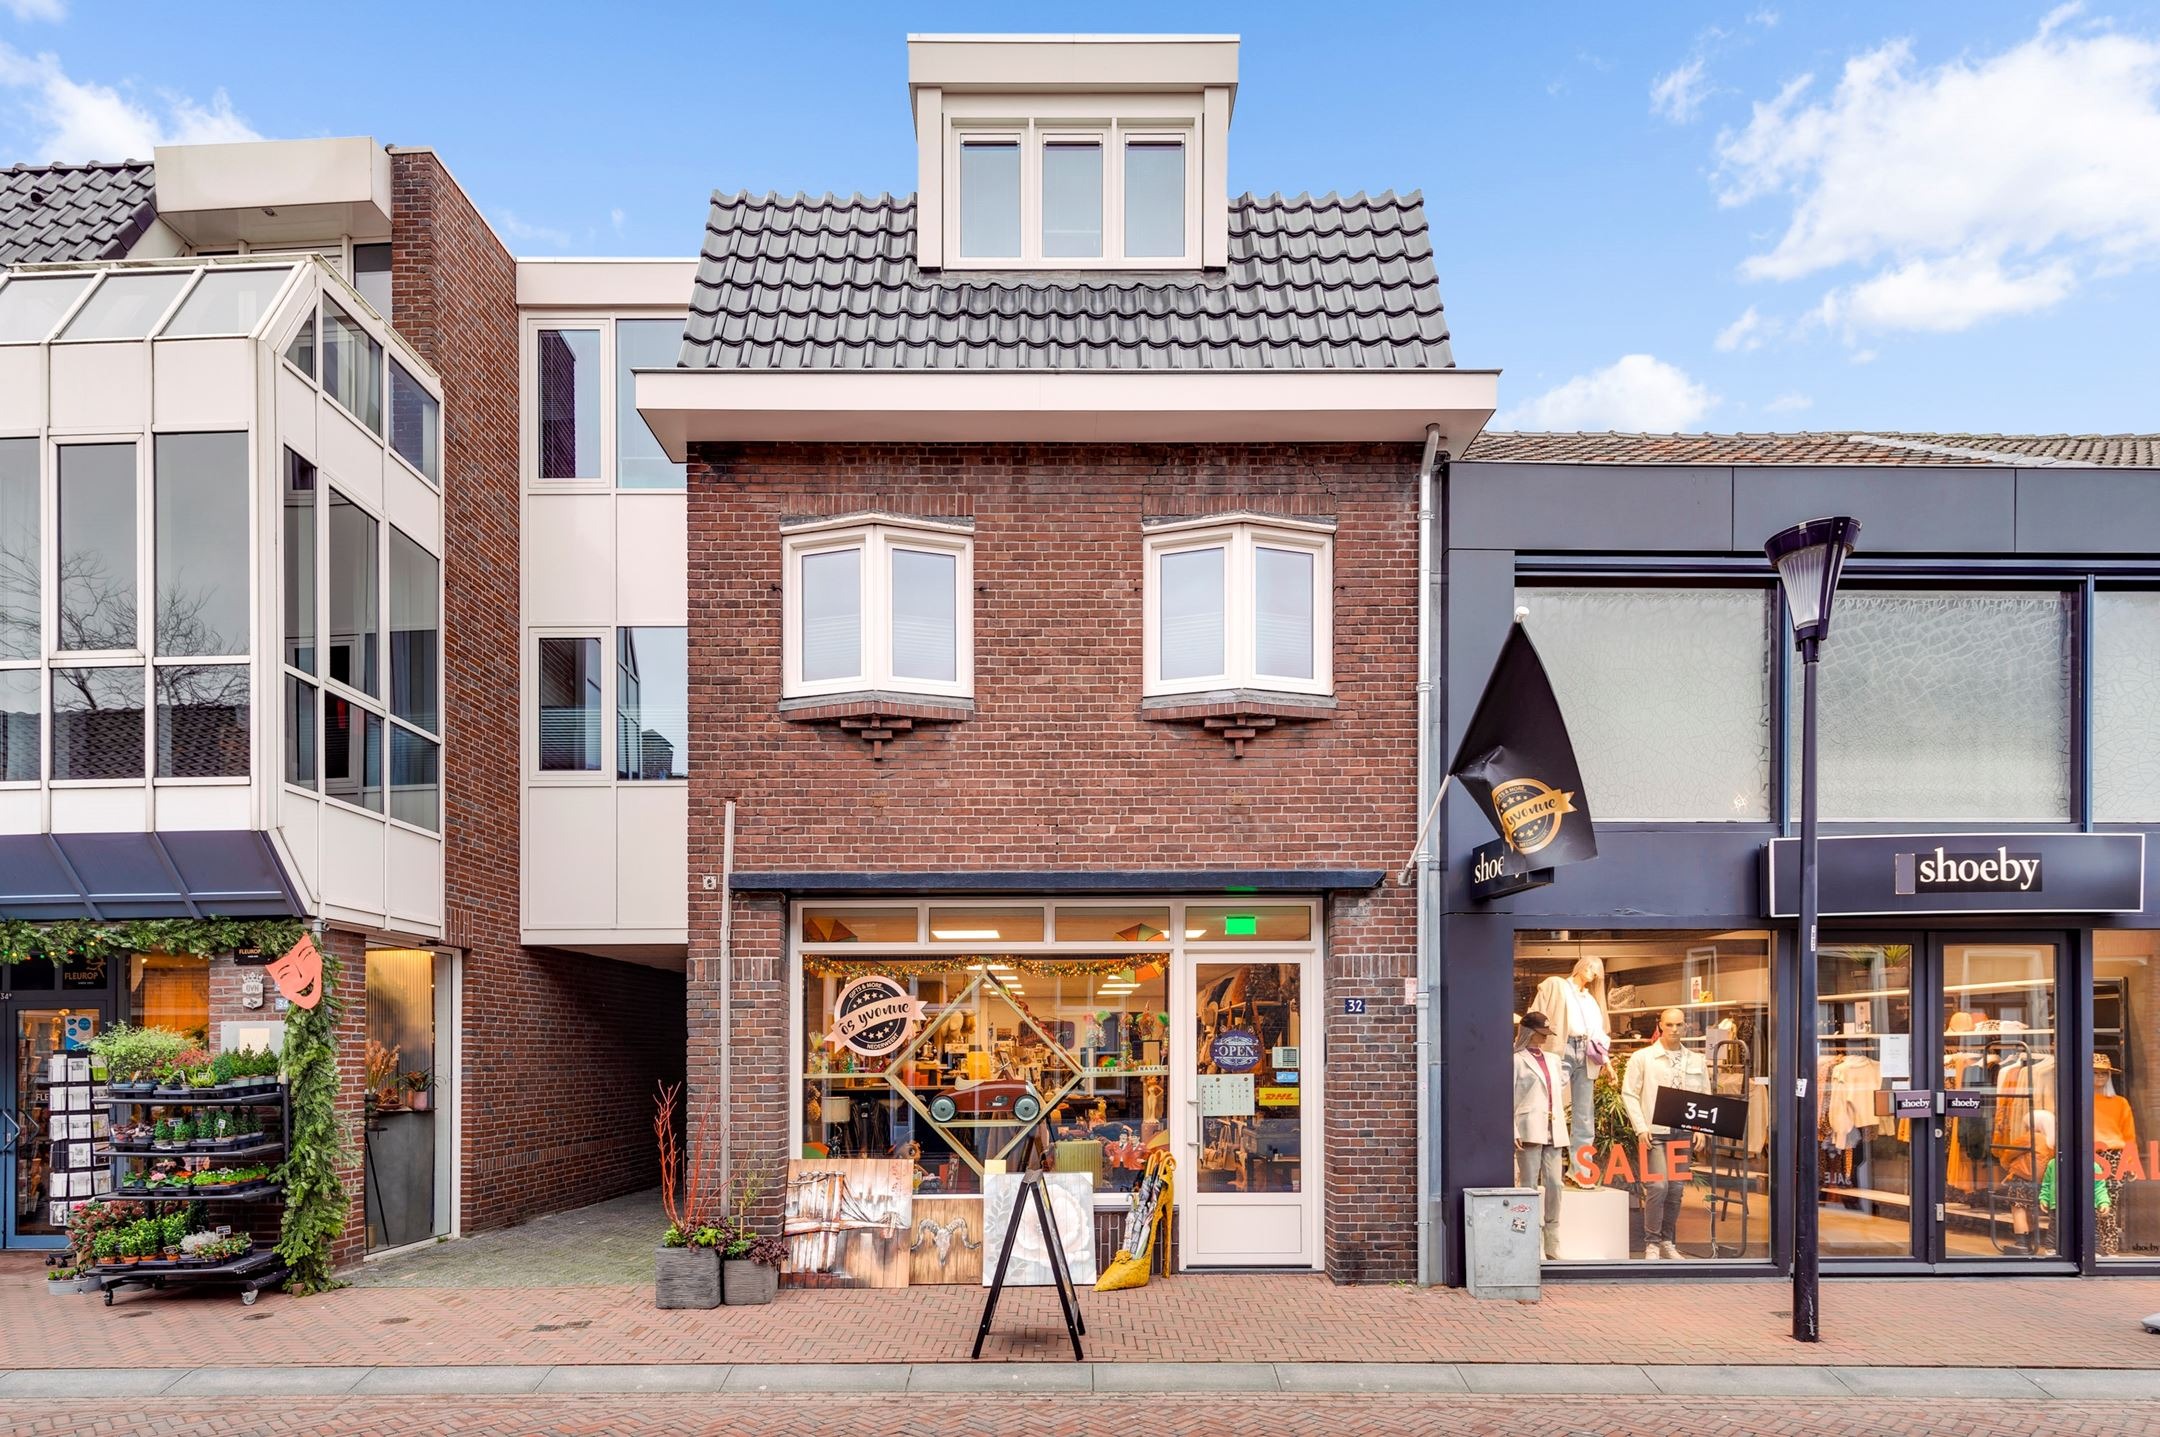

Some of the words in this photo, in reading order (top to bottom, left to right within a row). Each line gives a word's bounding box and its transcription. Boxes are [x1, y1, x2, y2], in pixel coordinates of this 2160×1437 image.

[1506, 798, 1557, 829] yvonne
[1475, 852, 1519, 884] shoe
[1920, 846, 2040, 890] shoeby
[64, 972, 98, 980] FLEUROP
[849, 985, 862, 998] GIFTS
[1348, 1000, 1362, 1012] 32
[858, 1003, 910, 1028] yvonne
[866, 1033, 900, 1049] NEDERWEERT
[1218, 1045, 1254, 1057] OPEN
[1901, 1098, 1930, 1109] shoeby
[1951, 1098, 1980, 1109] shoeby
[1684, 1102, 1718, 1124] 3=1
[1575, 1140, 1693, 1185] SALE
